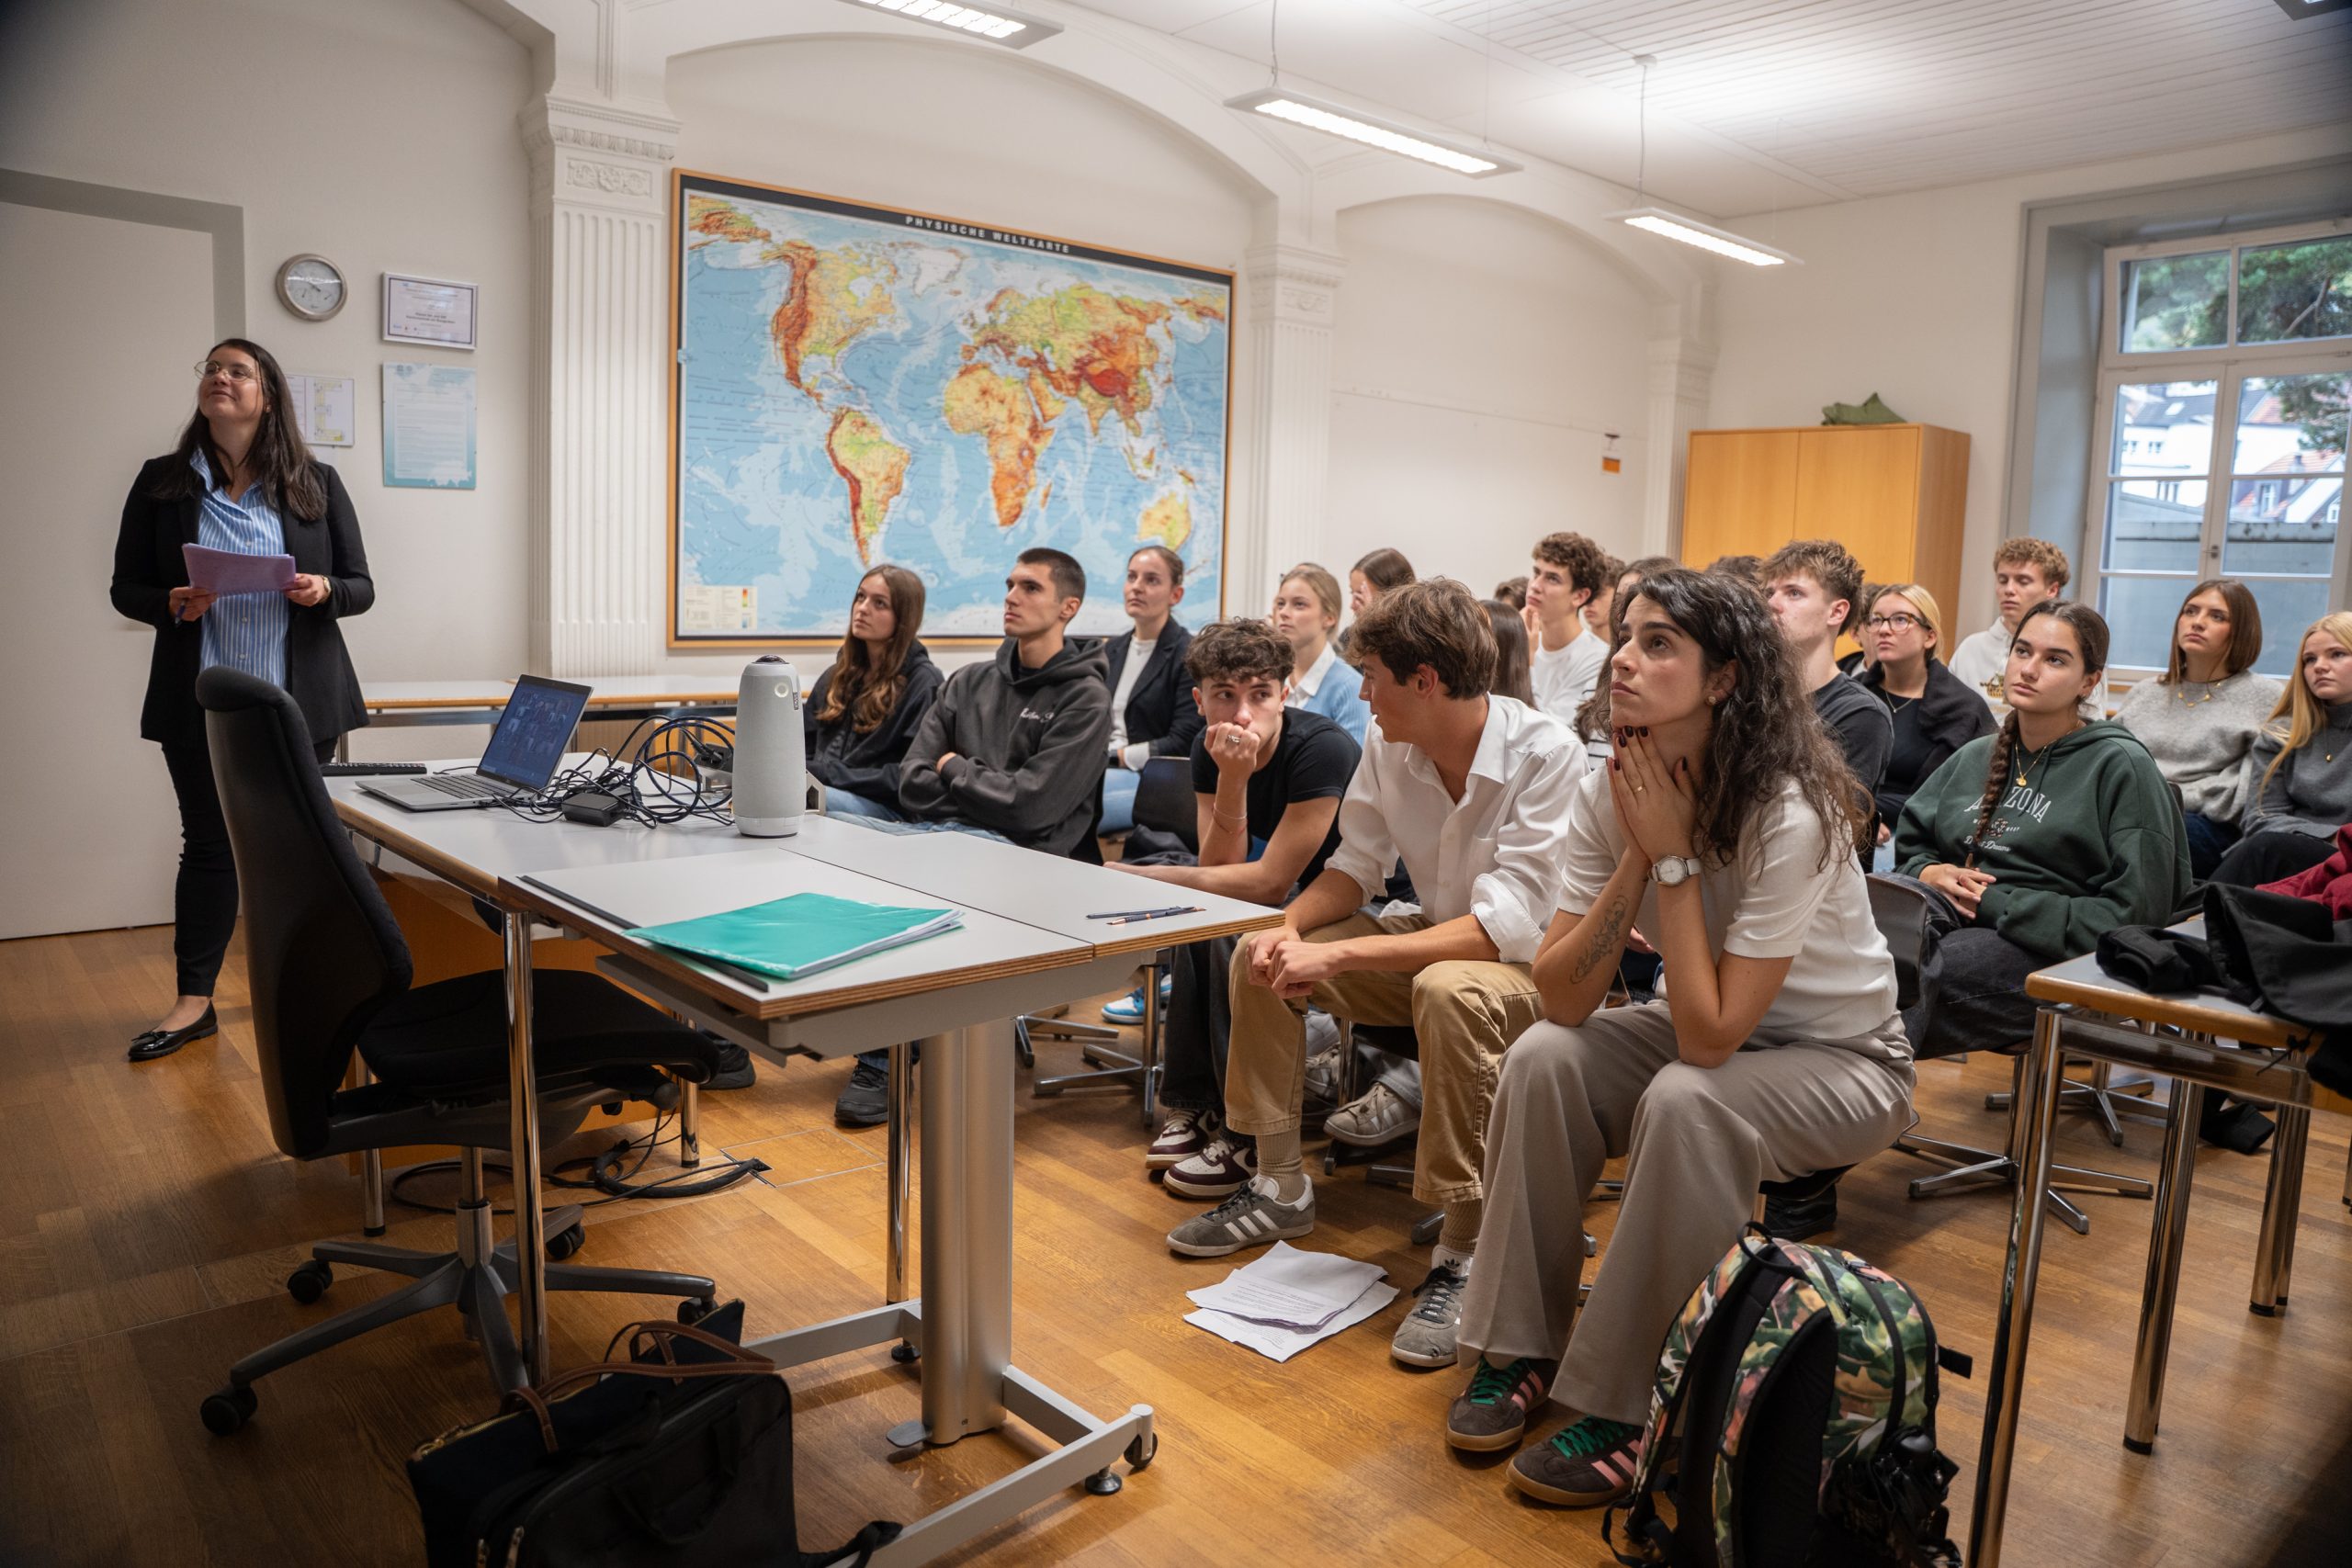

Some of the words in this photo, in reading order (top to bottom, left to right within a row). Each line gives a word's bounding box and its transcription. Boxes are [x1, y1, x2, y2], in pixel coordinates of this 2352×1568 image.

[905, 216, 985, 238] PHYSISCHE
[992, 231, 1069, 254] WELTKARTE
[1963, 786, 2052, 823] AZONA
